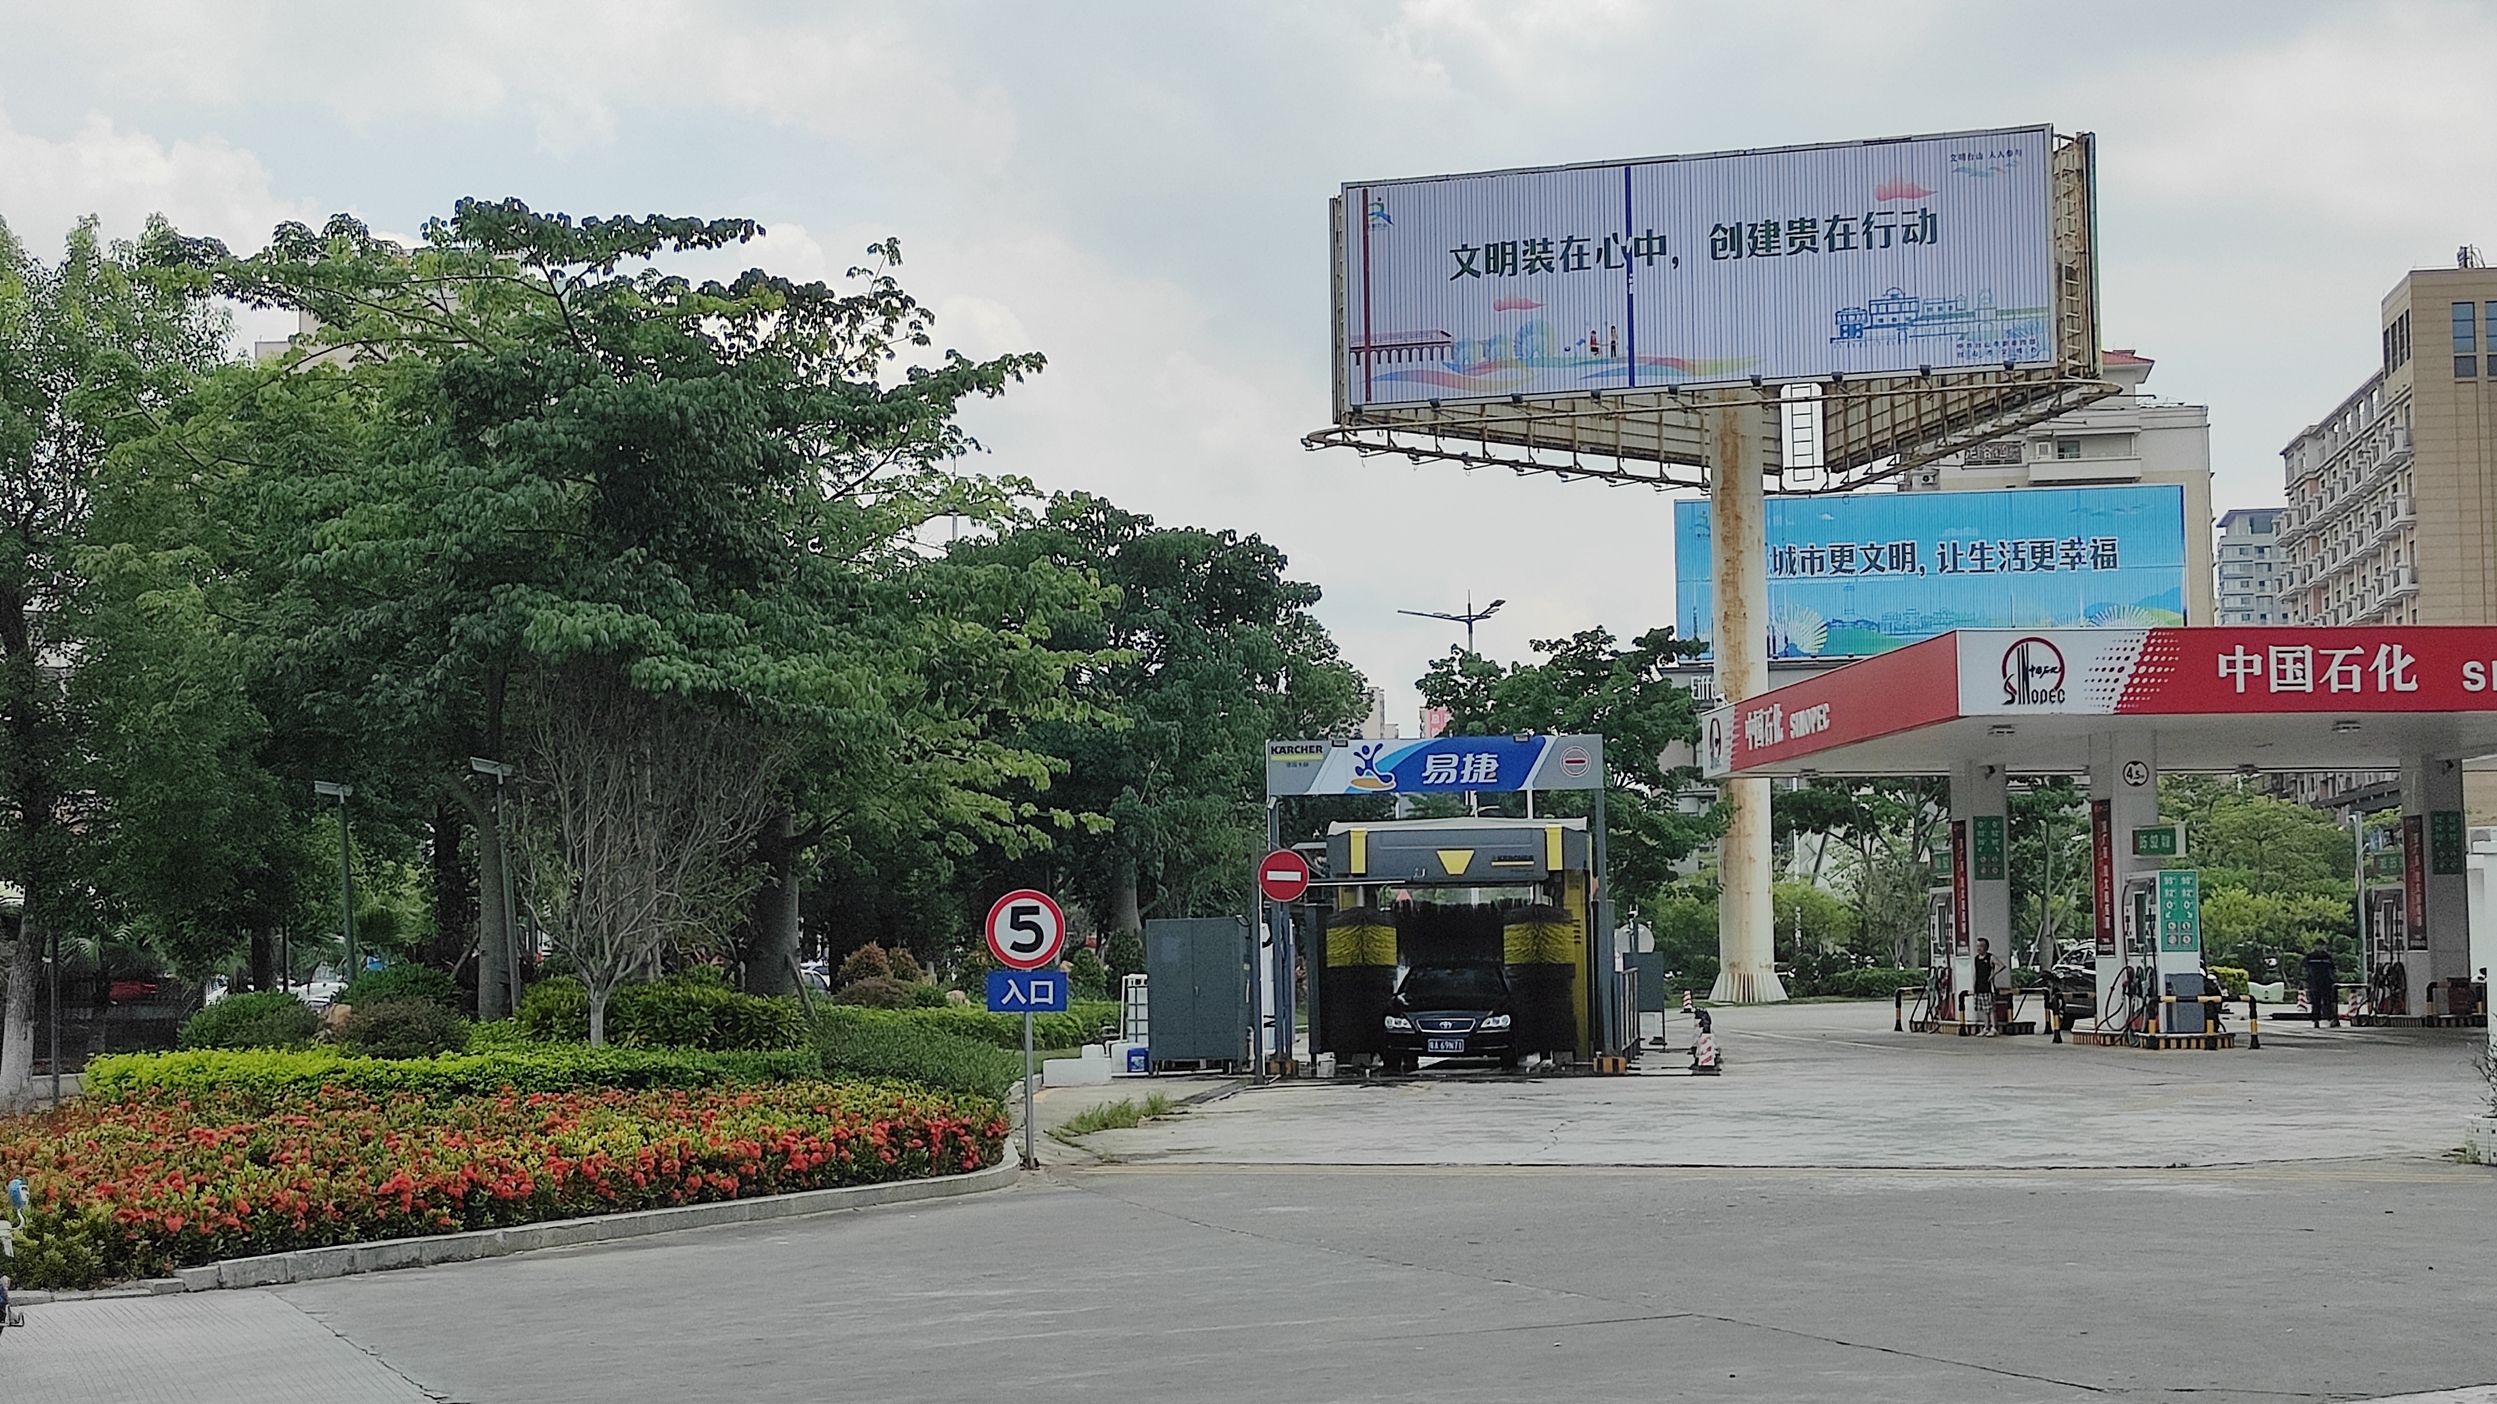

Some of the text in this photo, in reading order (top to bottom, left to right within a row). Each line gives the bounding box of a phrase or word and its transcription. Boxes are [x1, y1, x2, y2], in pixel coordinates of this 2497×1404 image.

[2218, 644, 2418, 694] 中国石化
[1745, 702, 1830, 751] 中国石化 SINOPEC
[1421, 753, 1499, 784] 易捷
[1010, 906, 1044, 953] 5
[1001, 979, 1054, 1005] 入口
